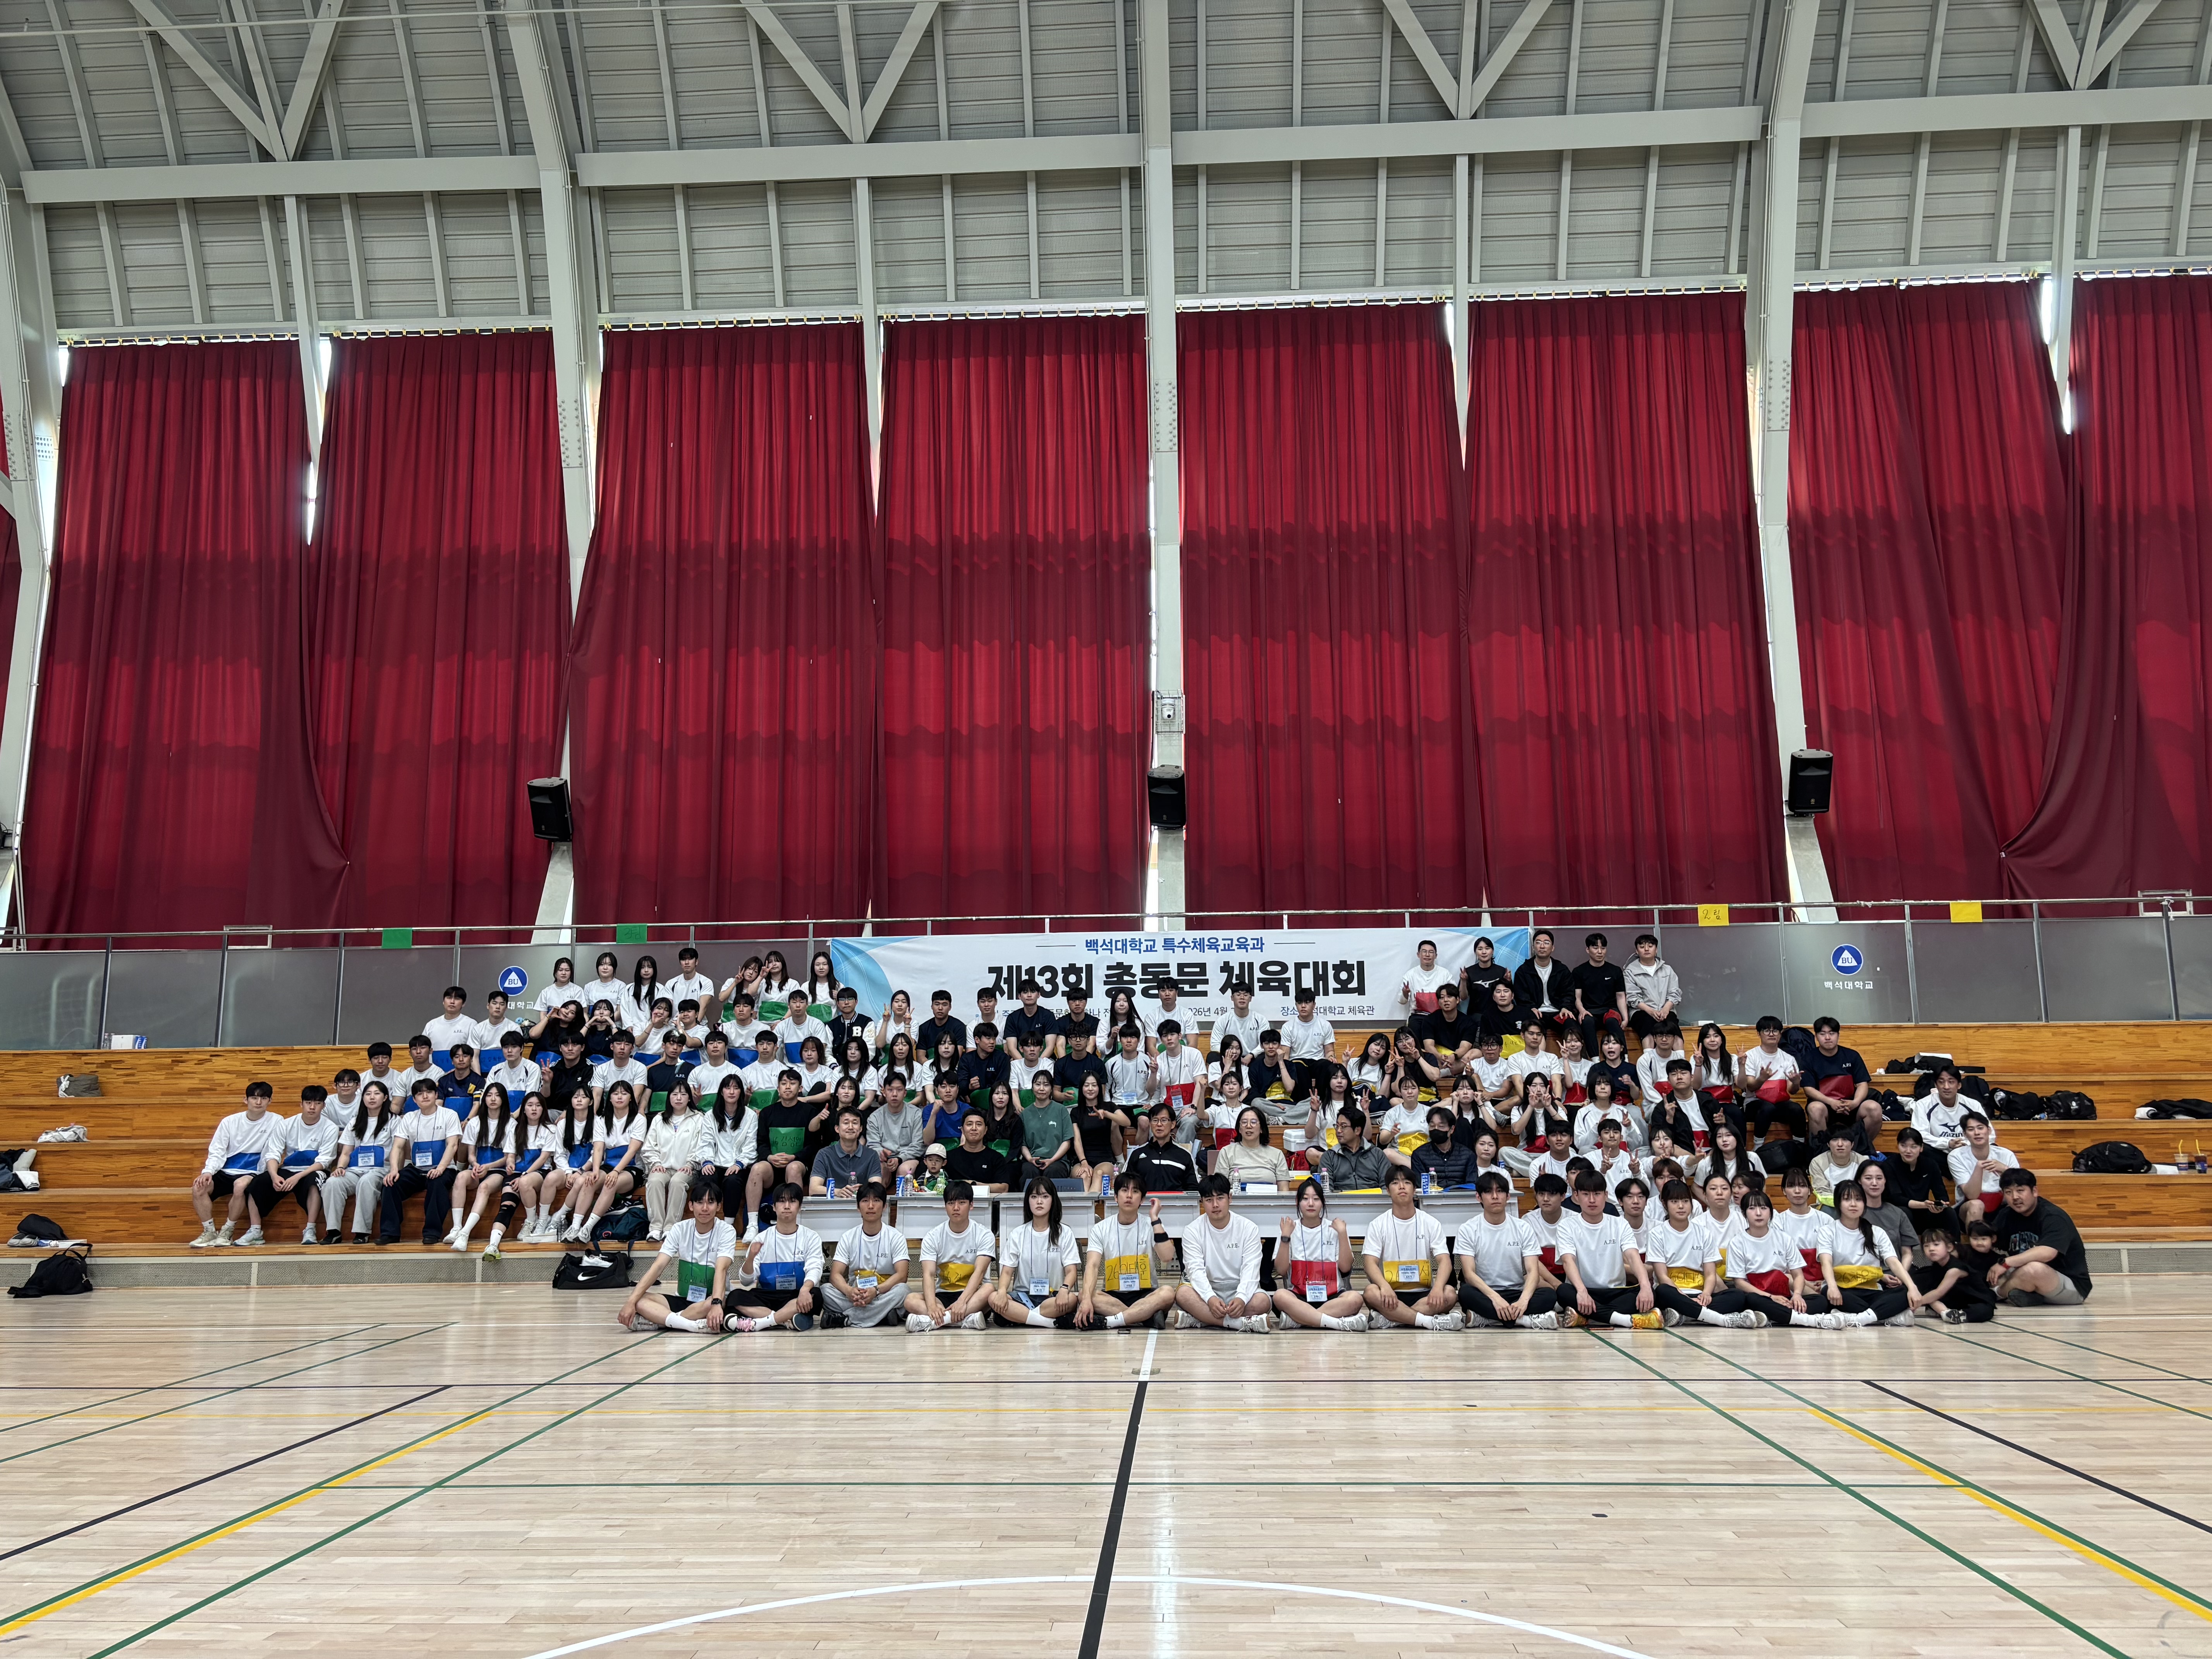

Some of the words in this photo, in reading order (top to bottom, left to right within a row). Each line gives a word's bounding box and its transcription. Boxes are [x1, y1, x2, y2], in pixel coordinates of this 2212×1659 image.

[1085, 938, 1158, 955] 백석대학교
[1162, 936, 1265, 953] 특수체육교육과
[1103, 962, 1209, 999] 총동문
[1219, 960, 1366, 997] 체육대회
[1824, 981, 1873, 990] 백석대학교
[508, 1001, 534, 1010] 대학교
[1348, 1005, 1375, 1016] 체육관
[852, 1026, 862, 1037] B
[867, 1029, 874, 1038] 2
[1106, 1263, 1120, 1281] 26
